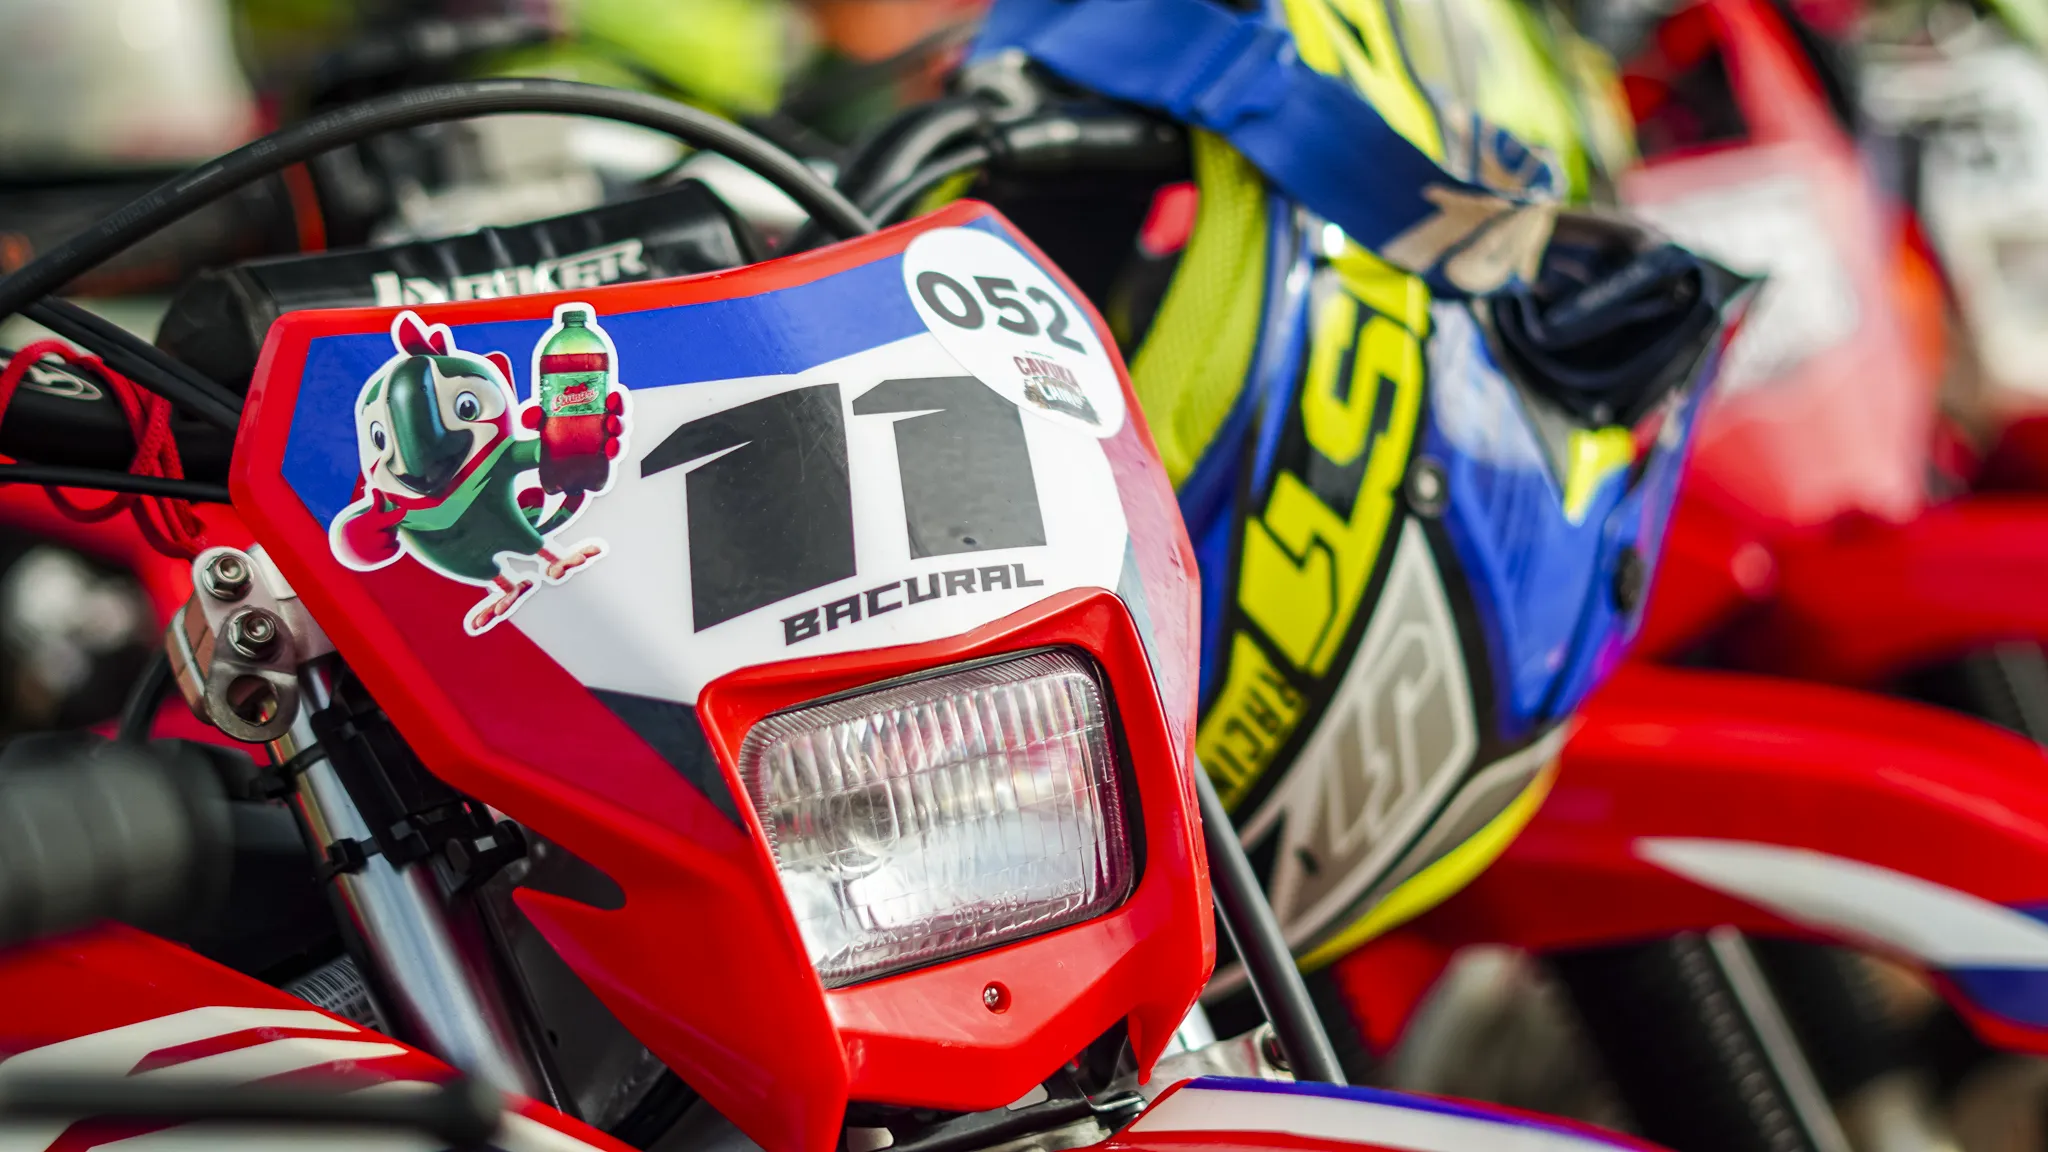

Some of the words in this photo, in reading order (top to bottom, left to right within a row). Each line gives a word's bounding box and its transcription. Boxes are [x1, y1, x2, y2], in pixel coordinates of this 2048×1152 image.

[916, 271, 1088, 356] 052
[640, 375, 1048, 634] 11
[780, 563, 1044, 646] BACURAL
